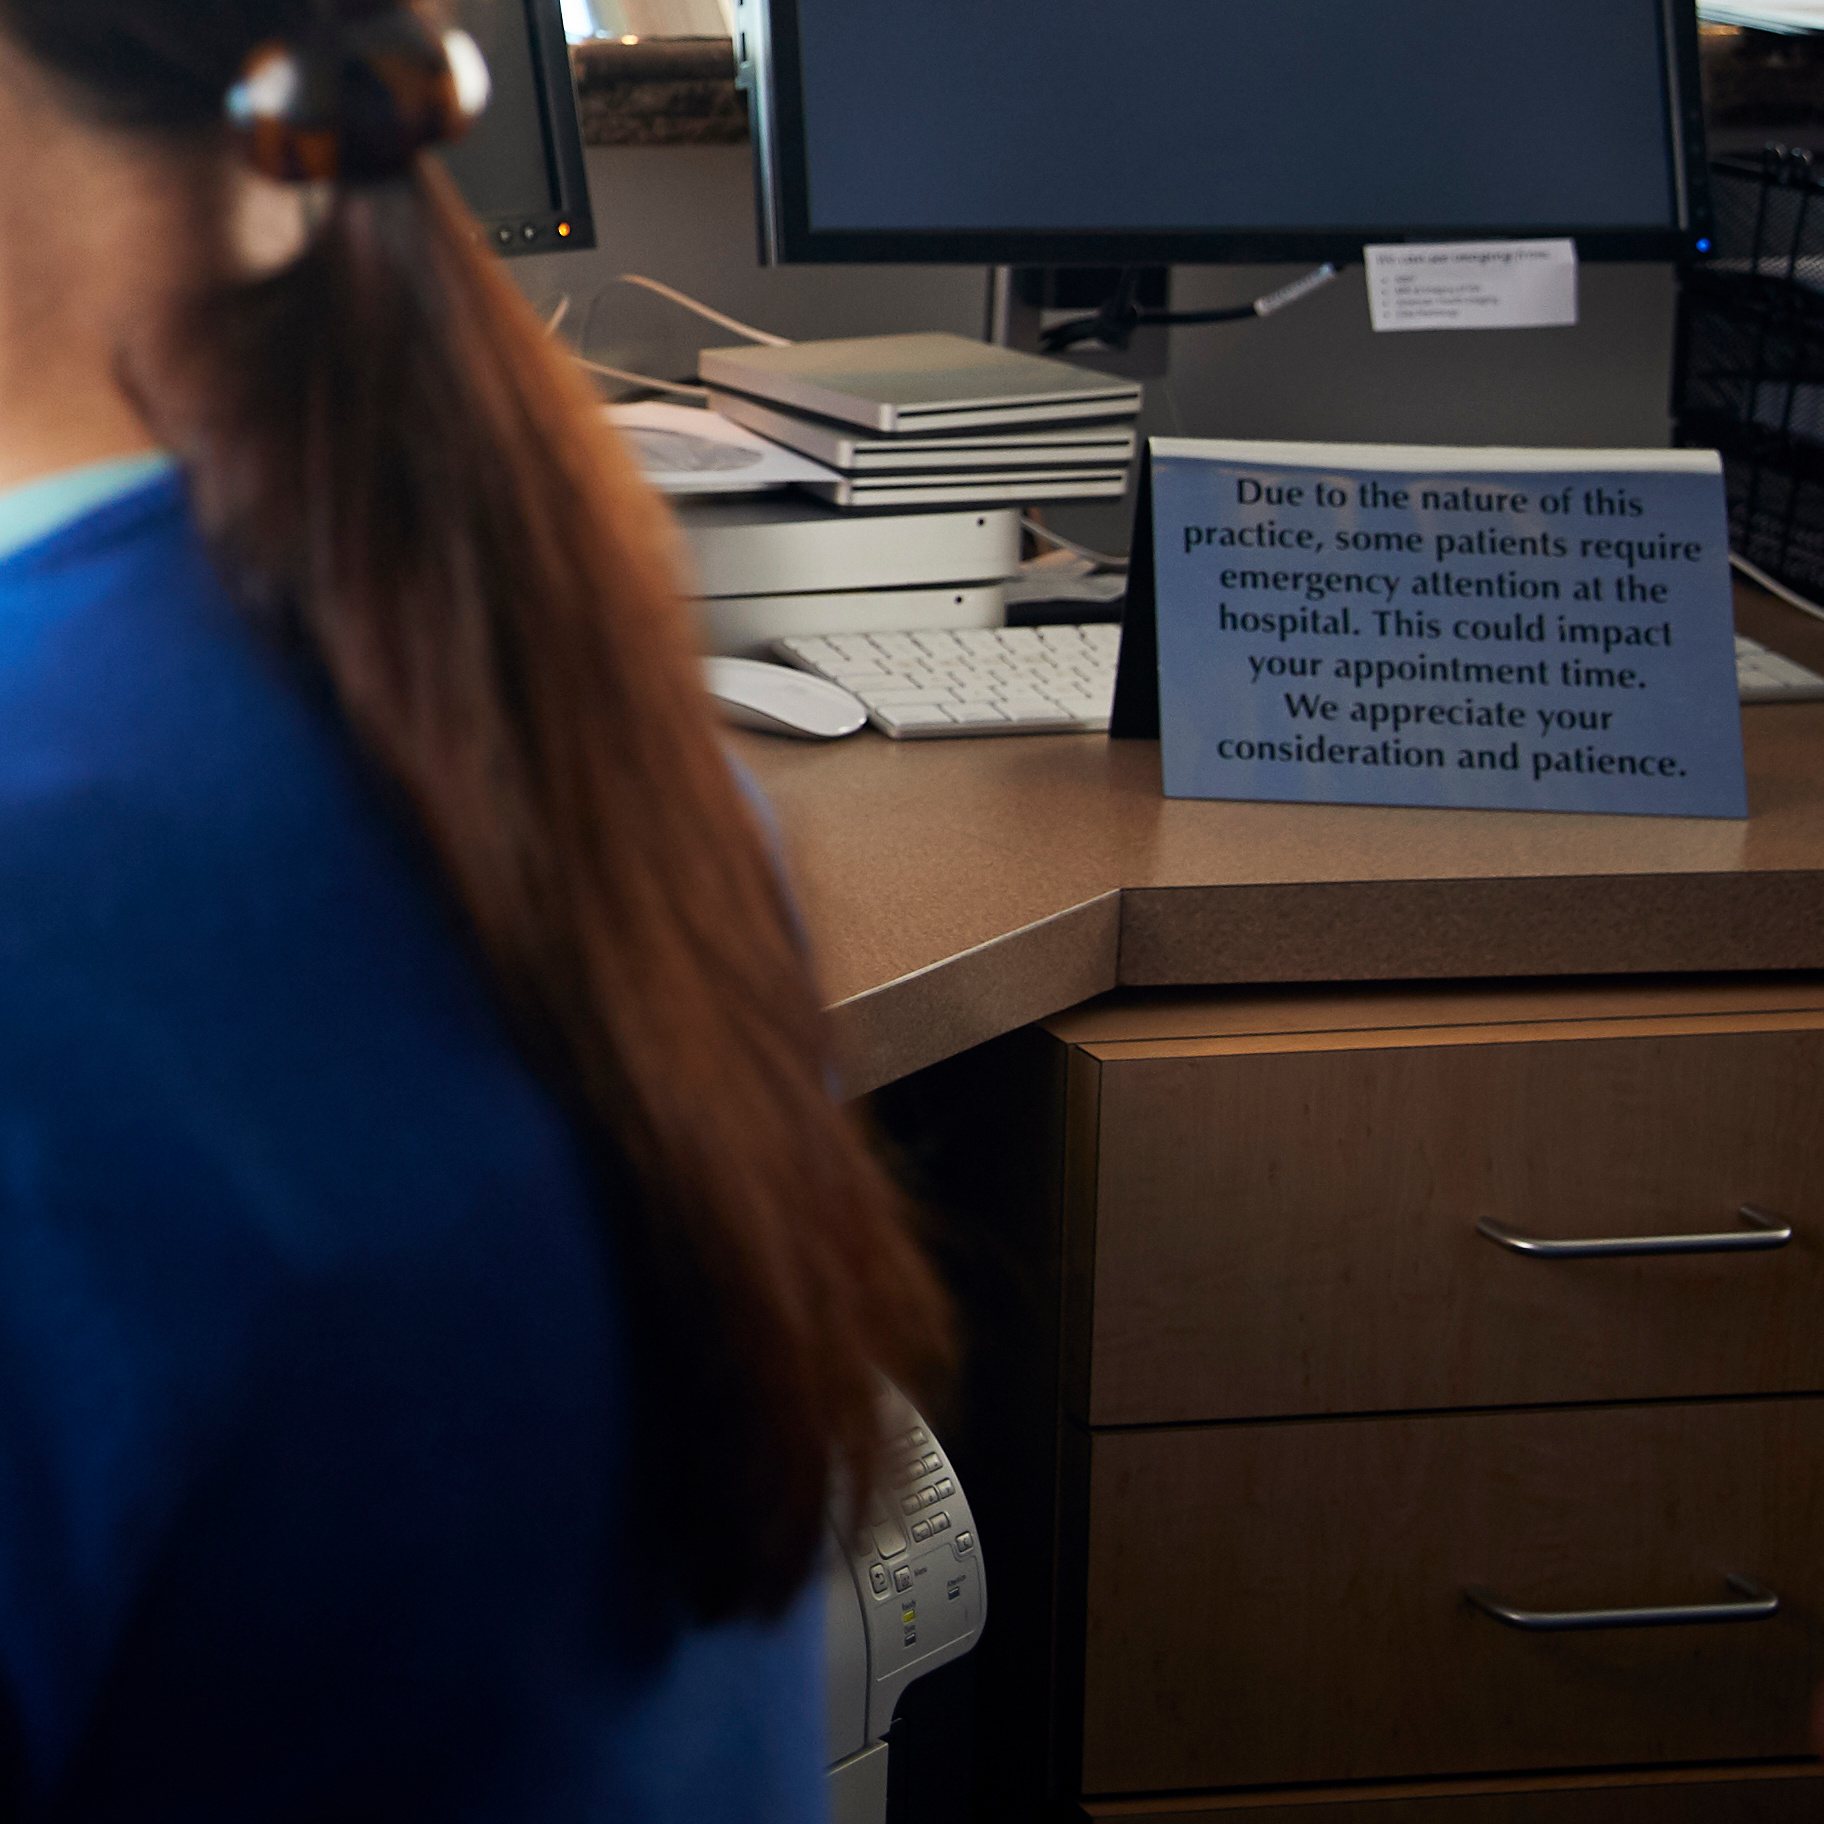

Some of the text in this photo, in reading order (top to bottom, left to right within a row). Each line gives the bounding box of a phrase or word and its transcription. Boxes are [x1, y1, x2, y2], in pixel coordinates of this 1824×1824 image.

[1237, 479, 1643, 515] Due to the nature of this
[1184, 522, 1701, 566] practice, some patients require
[1220, 570, 1667, 603] emergency attention at the
[1220, 604, 1670, 653] hospital. This could impact
[1249, 655, 1645, 688] your appointment time.
[1284, 693, 1612, 736] We appreciate your
[1217, 735, 1685, 781] consideration and patience.
